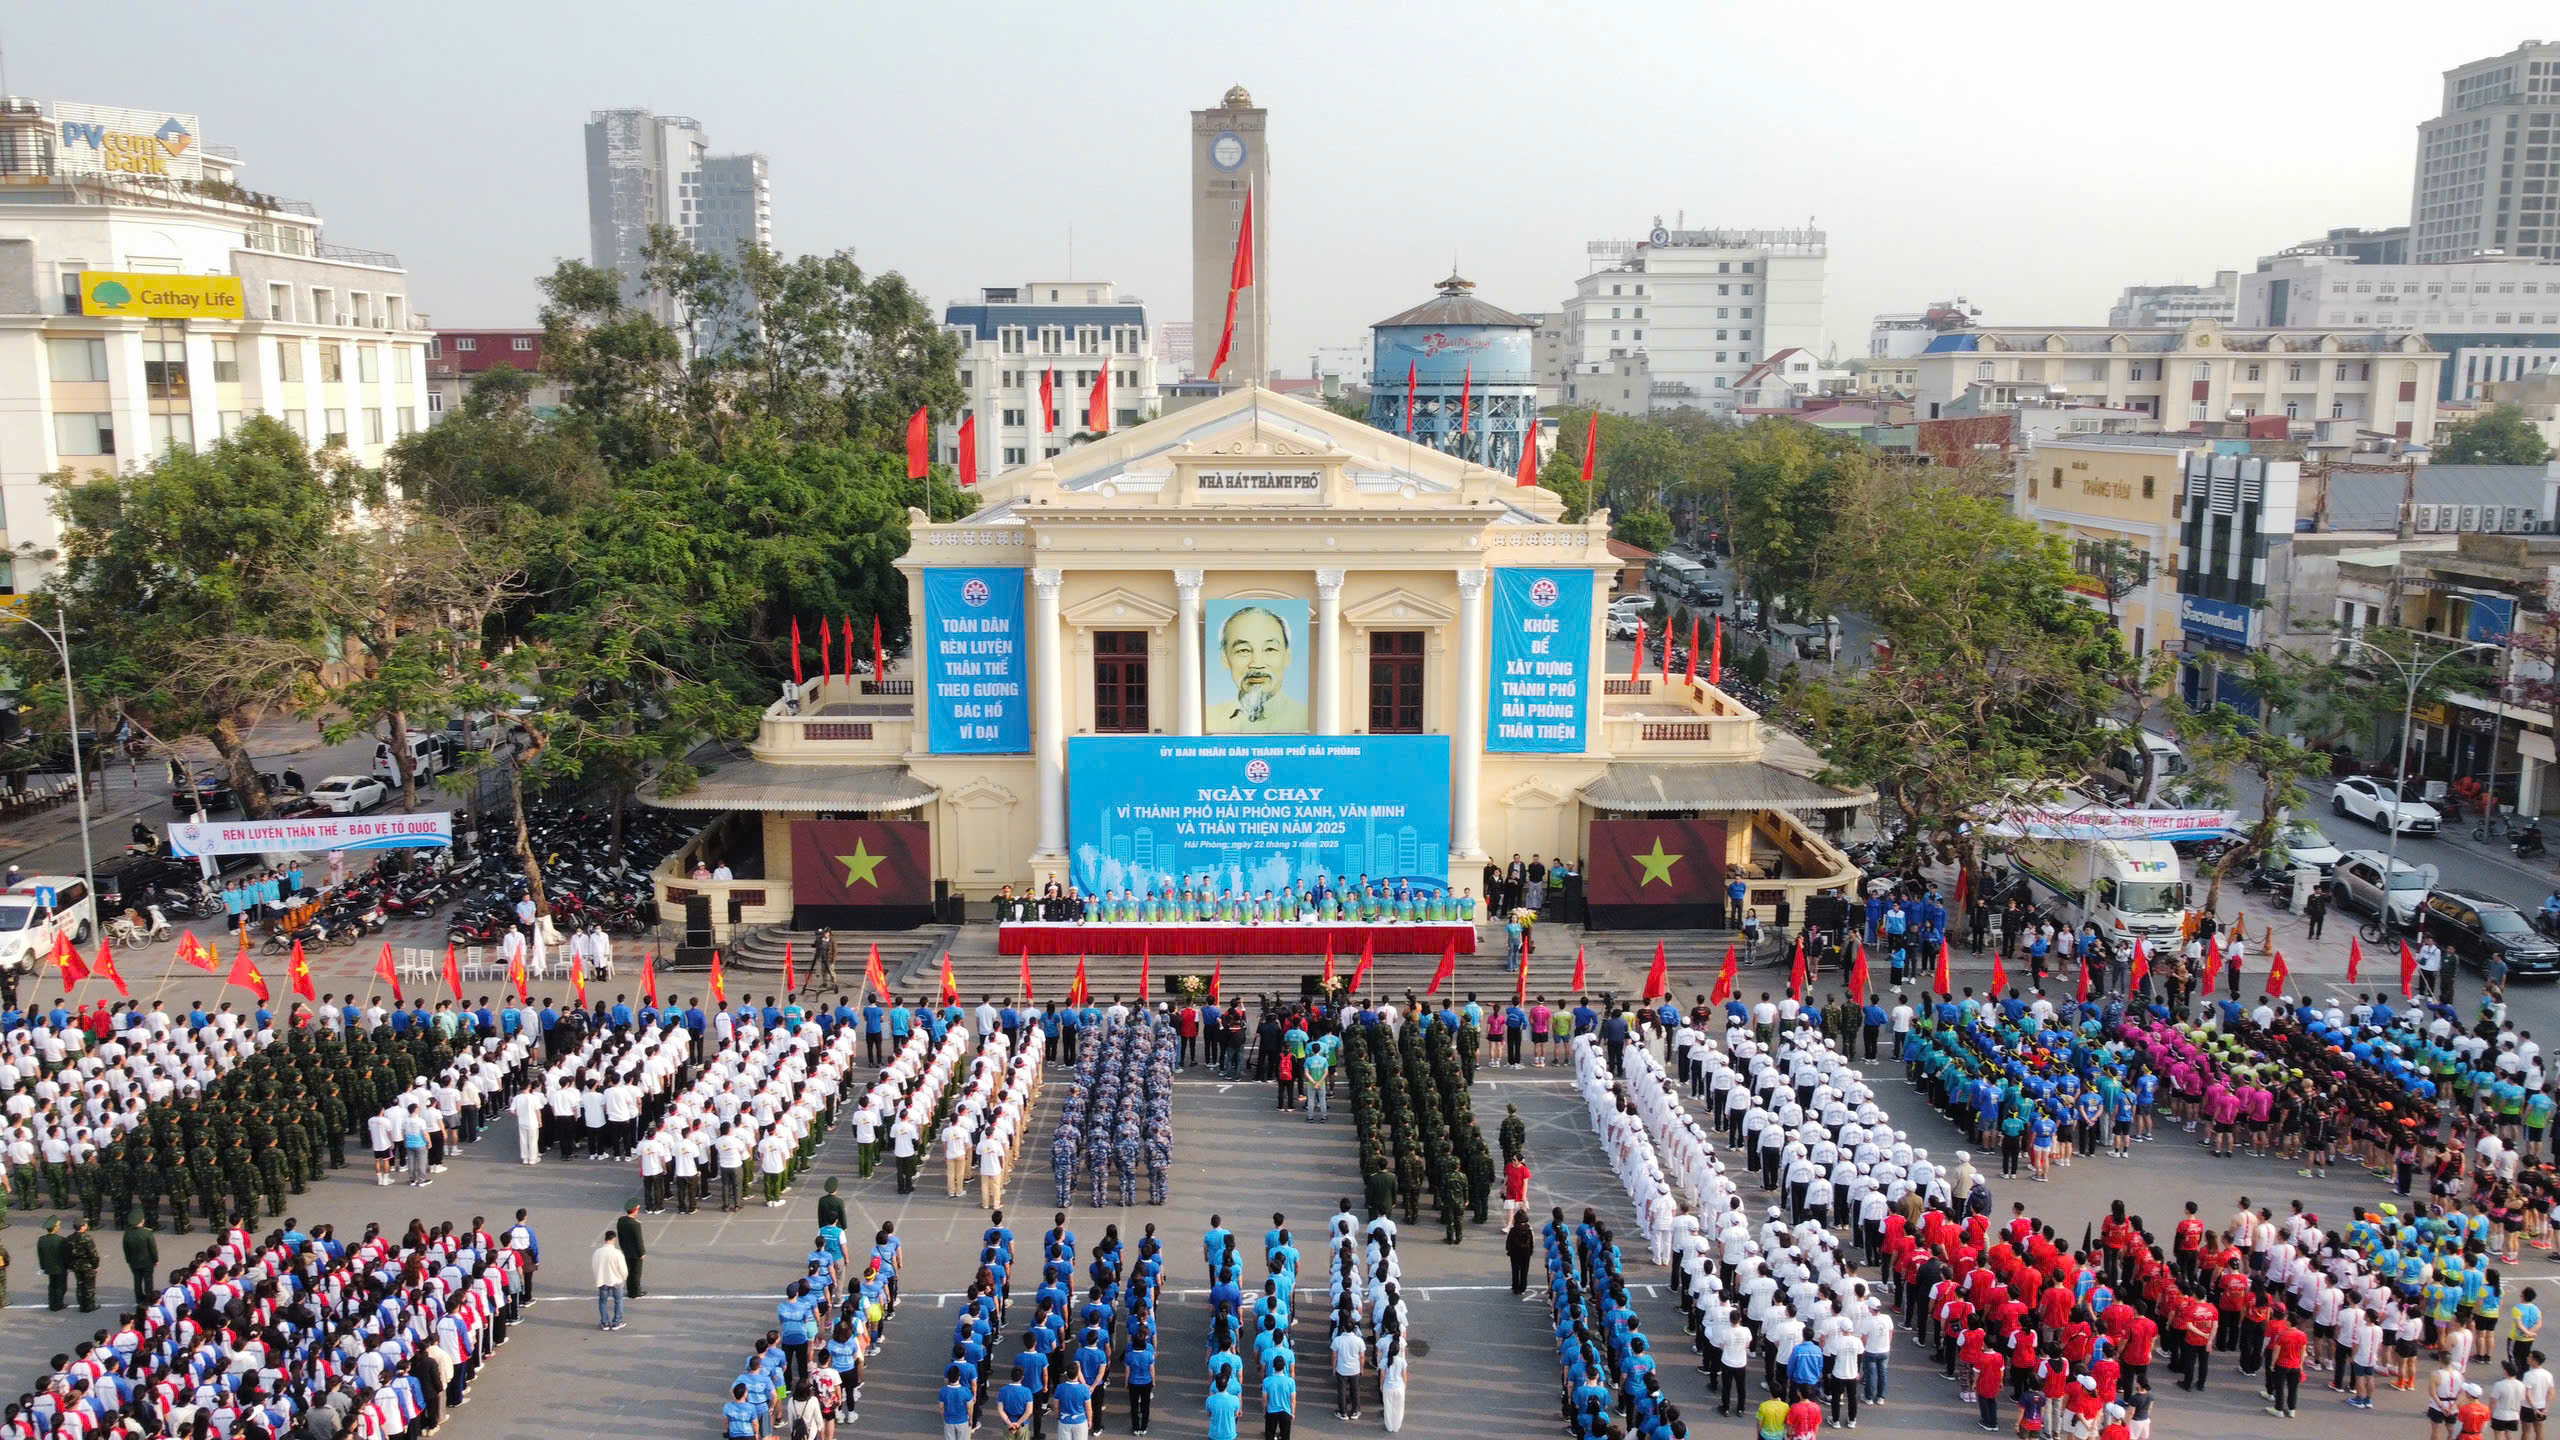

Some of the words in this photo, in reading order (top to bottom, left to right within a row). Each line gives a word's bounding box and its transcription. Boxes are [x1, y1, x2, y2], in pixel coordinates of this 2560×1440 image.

[104, 149, 169, 176] Bank
[140, 290, 200, 309] Cathay
[204, 292, 236, 307] Life
[1198, 472, 1224, 489] NHÀ
[1225, 472, 1250, 489] HÁT
[1251, 472, 1293, 489] THÀNH
[1294, 471, 1321, 489] PHỐ
[941, 616, 978, 633] TOÀN
[981, 617, 1010, 633] DÂN
[1523, 613, 1560, 633] KHỎE
[2182, 599, 2246, 633] Sacombank
[940, 638, 968, 655] RÈN
[970, 637, 1013, 656] LUYỆN
[945, 659, 981, 676] THÂN
[984, 656, 1009, 676] THỂ
[1506, 658, 1533, 676] XÂY
[1535, 660, 1573, 679] DỰNG
[937, 682, 970, 697] THEO
[973, 681, 1019, 697] GƯƠNG
[1501, 679, 1546, 697] THÀNH
[1549, 679, 1577, 697] PHỐ
[954, 701, 981, 718] BÁC
[984, 699, 1004, 718] HỒ
[1502, 698, 1526, 718] HẢI
[1527, 700, 1574, 718] PHÒNG
[959, 723, 973, 739] VĨ
[975, 725, 999, 742] ĐẠI
[1499, 721, 1534, 739] THÂN
[1537, 721, 1576, 742] THIỆN
[1160, 744, 1173, 757] ỦY
[1175, 747, 1197, 757] BAN
[1199, 745, 1226, 757] NHÂN
[1229, 745, 1250, 757] DÂN
[1252, 745, 1283, 757] THÀNH
[1286, 744, 1307, 756] PHỐ
[1308, 744, 1326, 756] HẢI
[1327, 745, 1361, 756] PHÒNG
[1197, 785, 1258, 801] NGÀY
[1263, 788, 1324, 804] CHẠY
[1116, 803, 1131, 819] VÌ
[1133, 803, 1180, 819] THÀNH
[1183, 802, 1214, 819] PHỐ
[1215, 803, 1240, 819] HẢI
[1242, 803, 1291, 818] PHÒNG
[1294, 805, 1336, 819] XANH,
[1339, 803, 1368, 818] VĂN
[1370, 805, 1405, 818] MINH
[408, 818, 438, 834] QUỐC
[1176, 819, 1196, 835] VÀ
[1198, 819, 1236, 835] THÂN
[1239, 820, 1279, 837] THIỆN
[1282, 819, 1313, 835] NĂM
[1316, 821, 1346, 834] 2025
[1183, 840, 1198, 849] Hải
[1231, 841, 1253, 851] ngày
[1254, 840, 1265, 849] 22
[1266, 840, 1291, 850] tháng
[1291, 840, 1298, 849] 3
[1299, 840, 1318, 849] năm
[1319, 840, 1340, 849] 2025
[2128, 860, 2169, 873] THP
